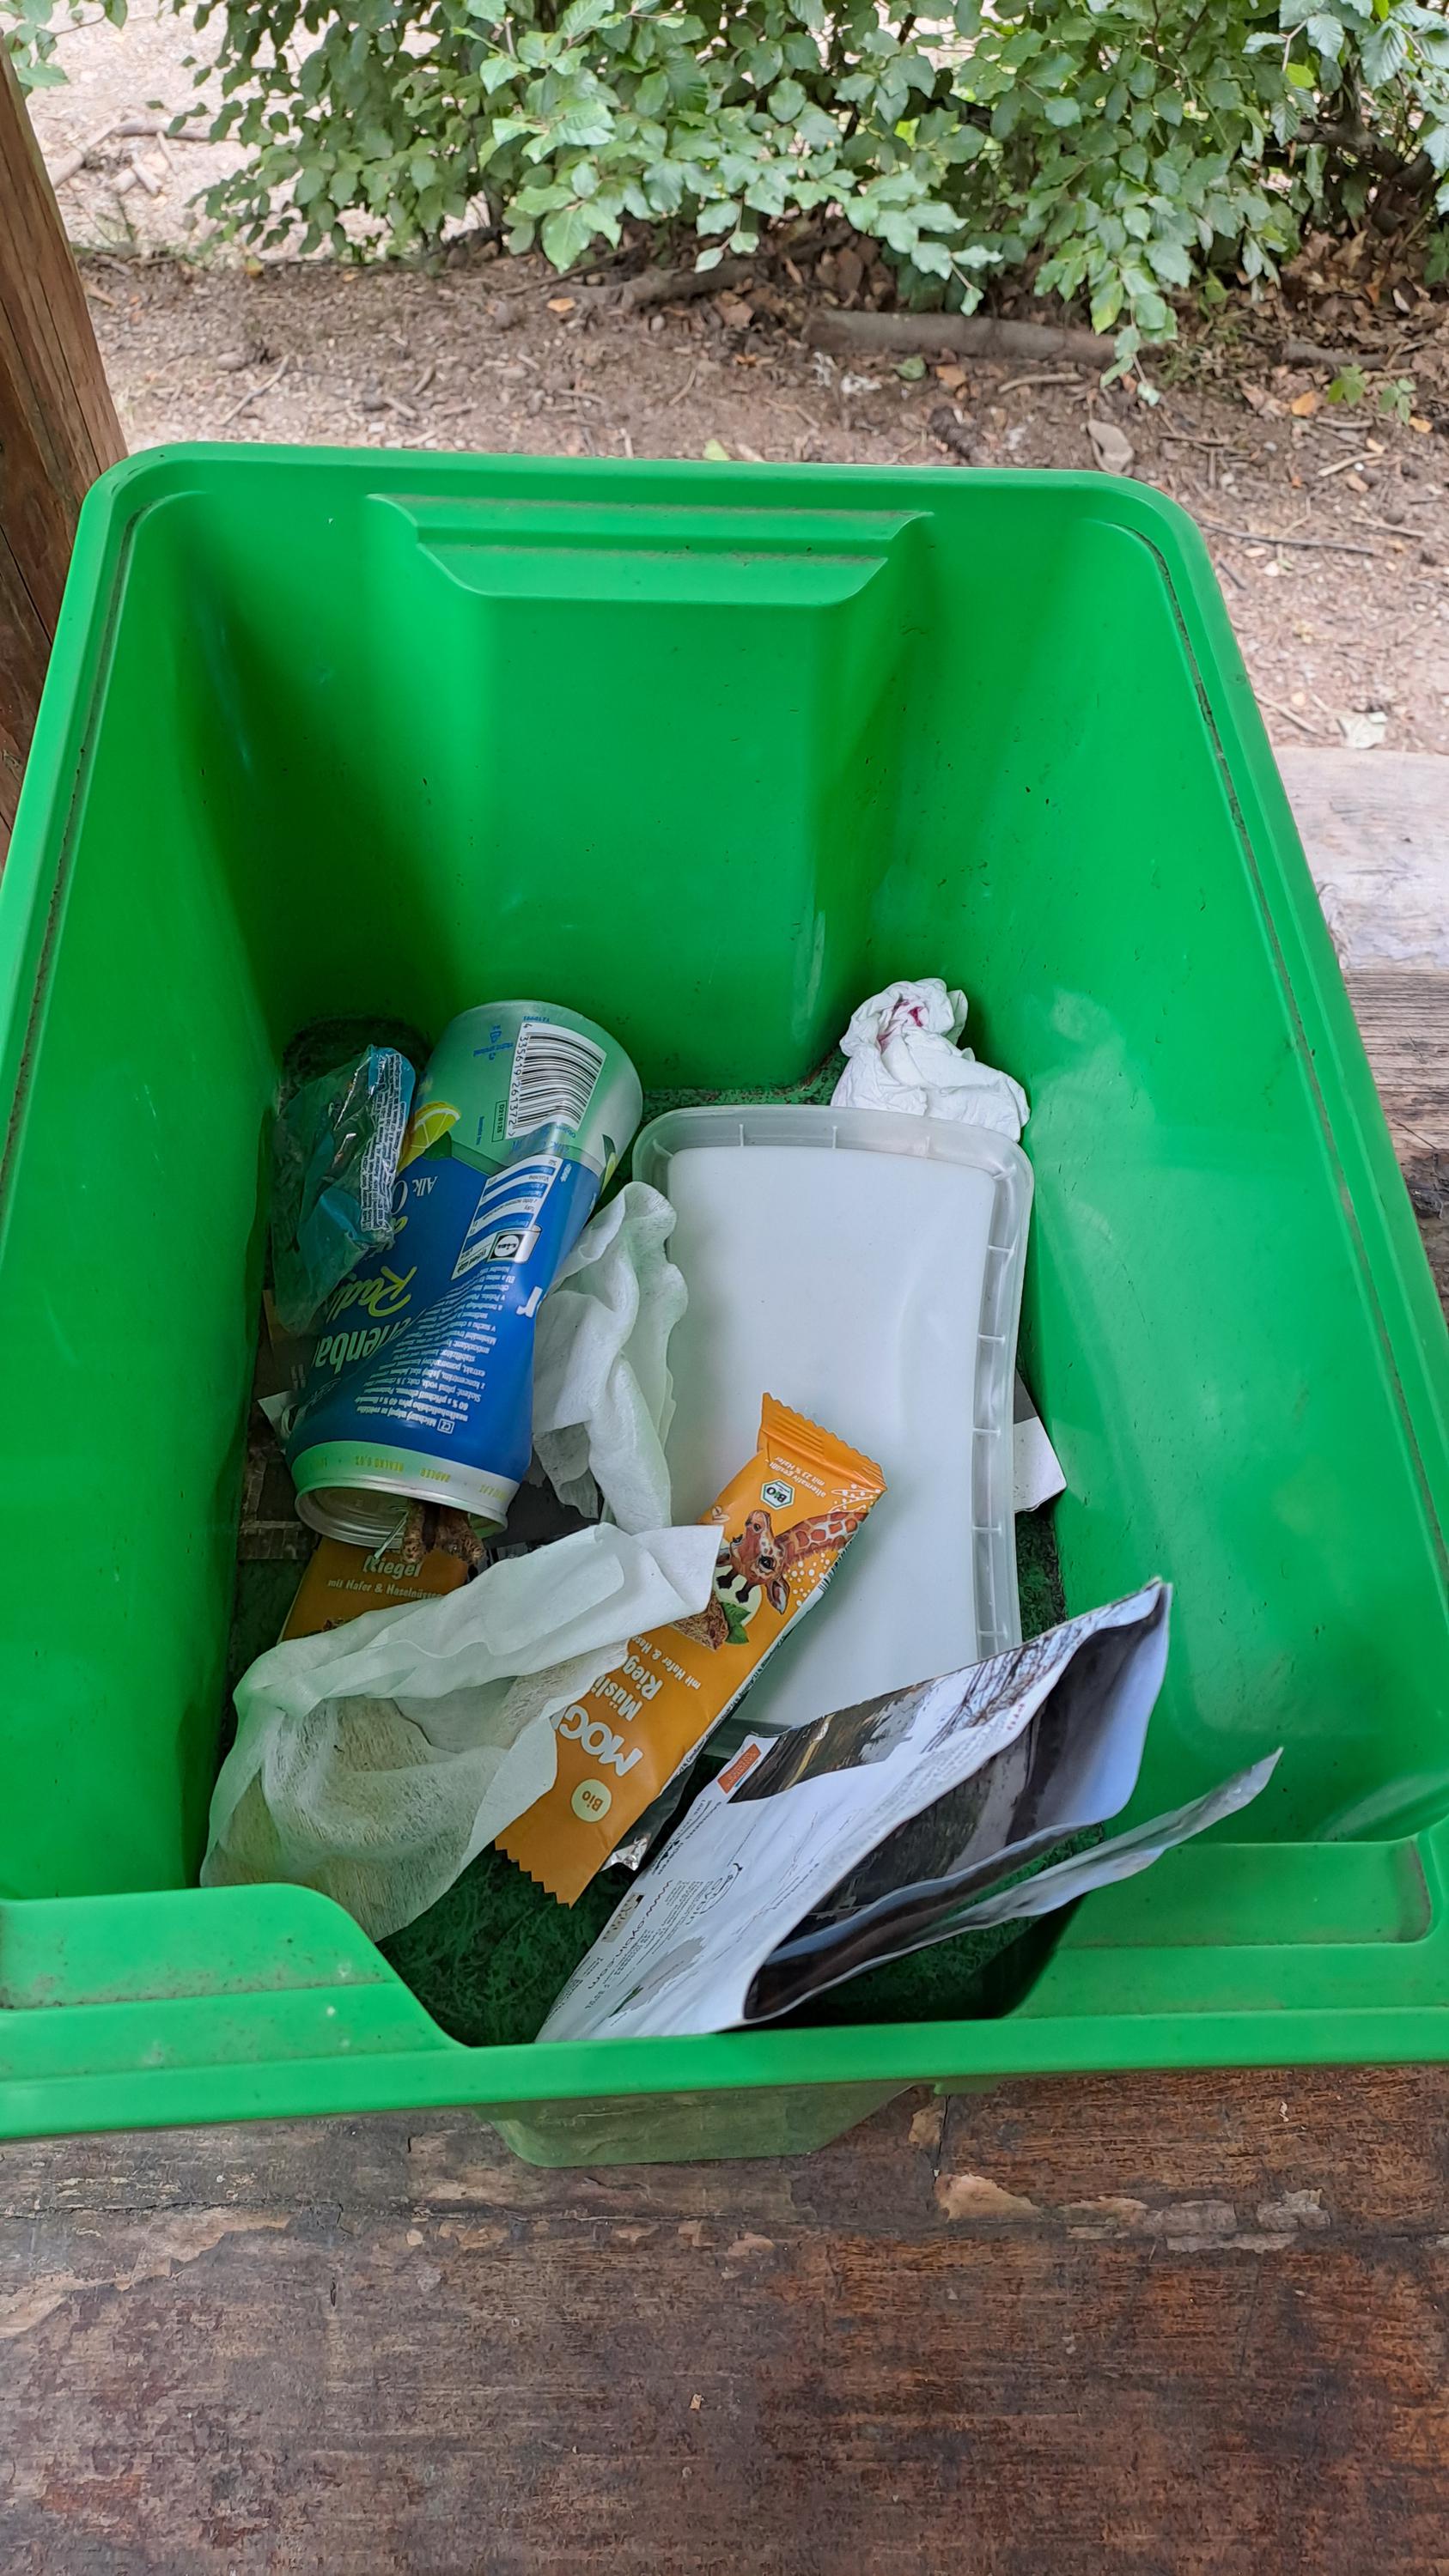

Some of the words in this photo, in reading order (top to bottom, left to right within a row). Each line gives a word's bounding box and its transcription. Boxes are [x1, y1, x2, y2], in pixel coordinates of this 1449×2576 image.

[513, 1036, 527, 1075] 335619
[508, 1081, 518, 1125] 261372
[792, 1473, 826, 1498] alternativ
[345, 1579, 372, 1592] Hafer
[618, 1654, 664, 1701] Rieg
[658, 1654, 687, 1681] Hafer
[681, 1674, 702, 1693] mit
[555, 1701, 644, 1777] MOG
[579, 1789, 603, 1812] Bio
[587, 1879, 673, 1990] www.oybin.com
